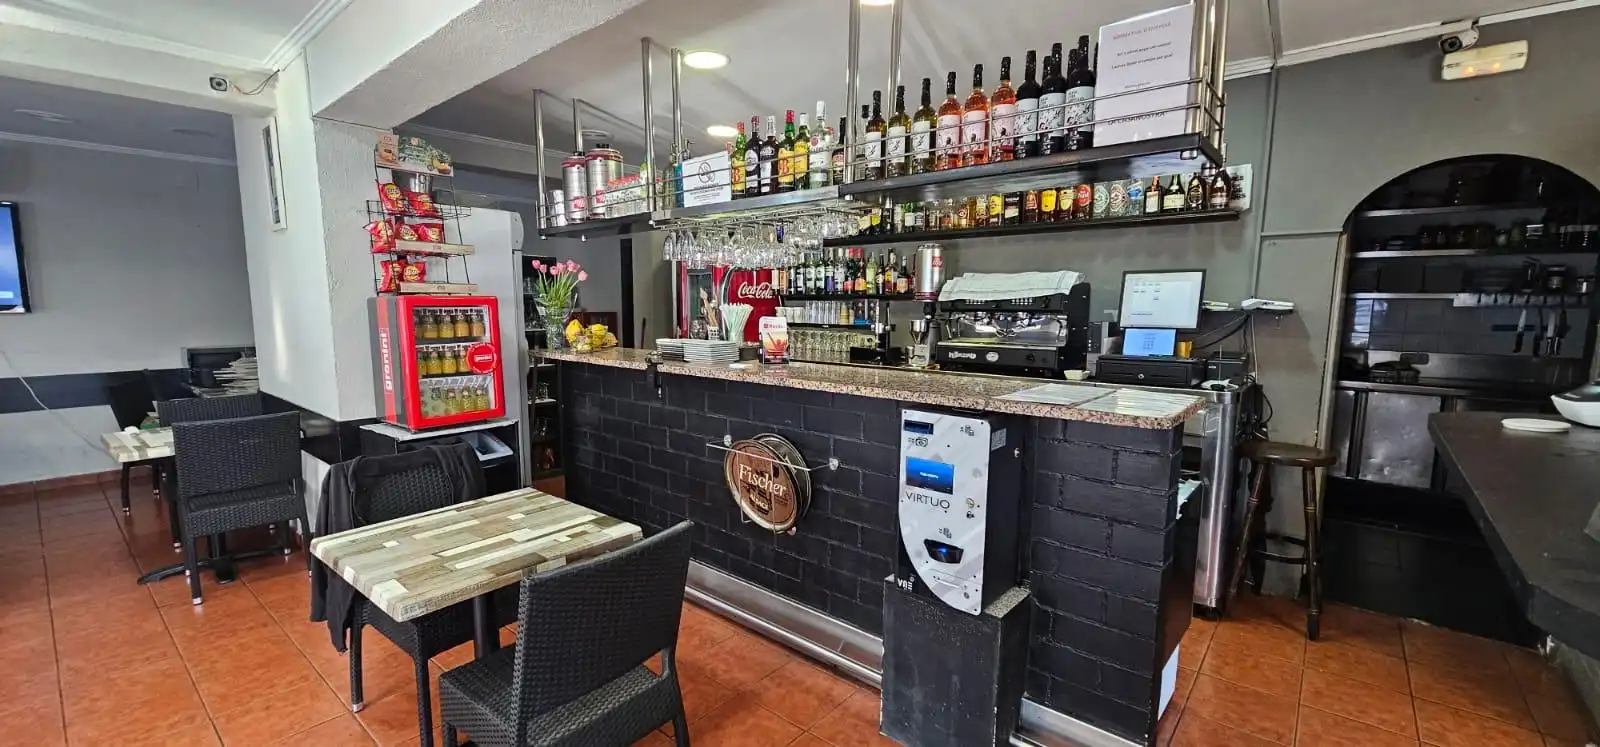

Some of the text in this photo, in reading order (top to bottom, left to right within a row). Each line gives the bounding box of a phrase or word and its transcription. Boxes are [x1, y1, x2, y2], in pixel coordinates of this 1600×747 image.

[380, 331, 393, 392] granini
[739, 463, 787, 496] Fischer
[905, 491, 951, 511] VIRTUO
